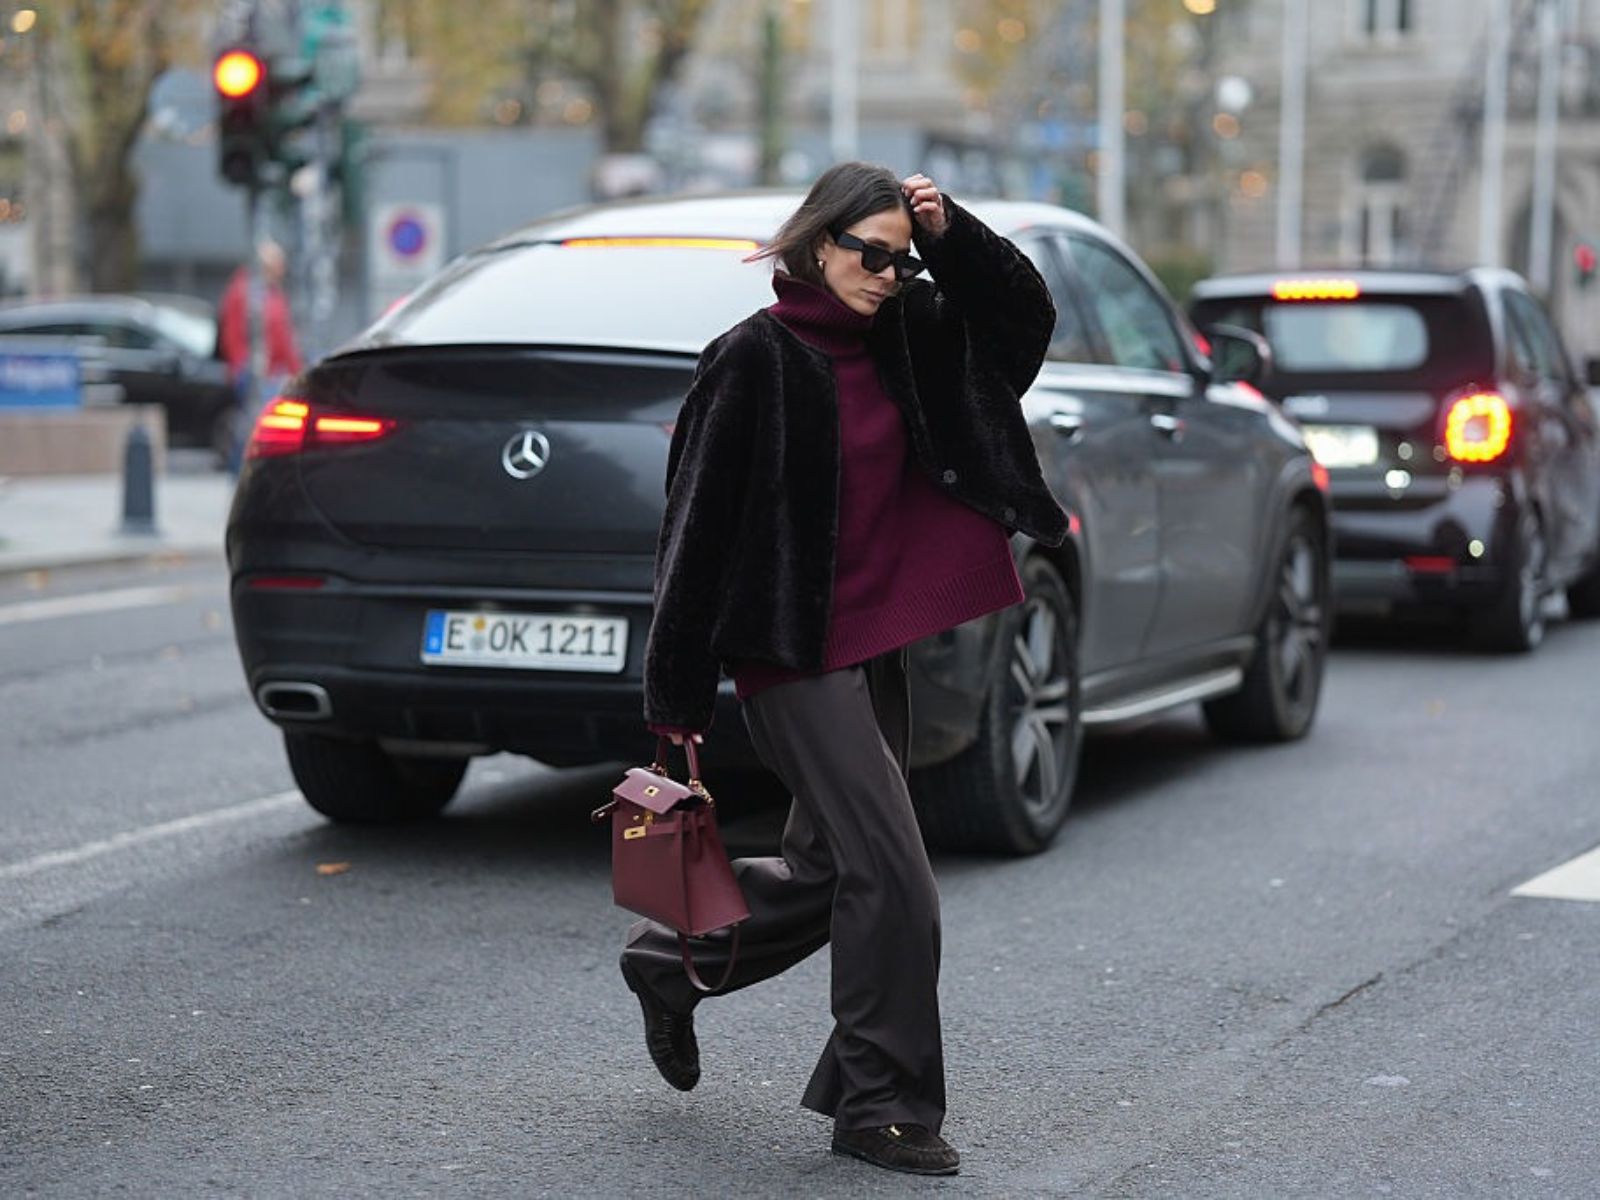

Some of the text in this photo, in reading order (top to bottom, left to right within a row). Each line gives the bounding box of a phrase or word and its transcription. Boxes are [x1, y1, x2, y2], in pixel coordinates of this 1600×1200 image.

[447, 618, 465, 650] E
[489, 621, 529, 653] OK
[538, 623, 617, 656] 1211
